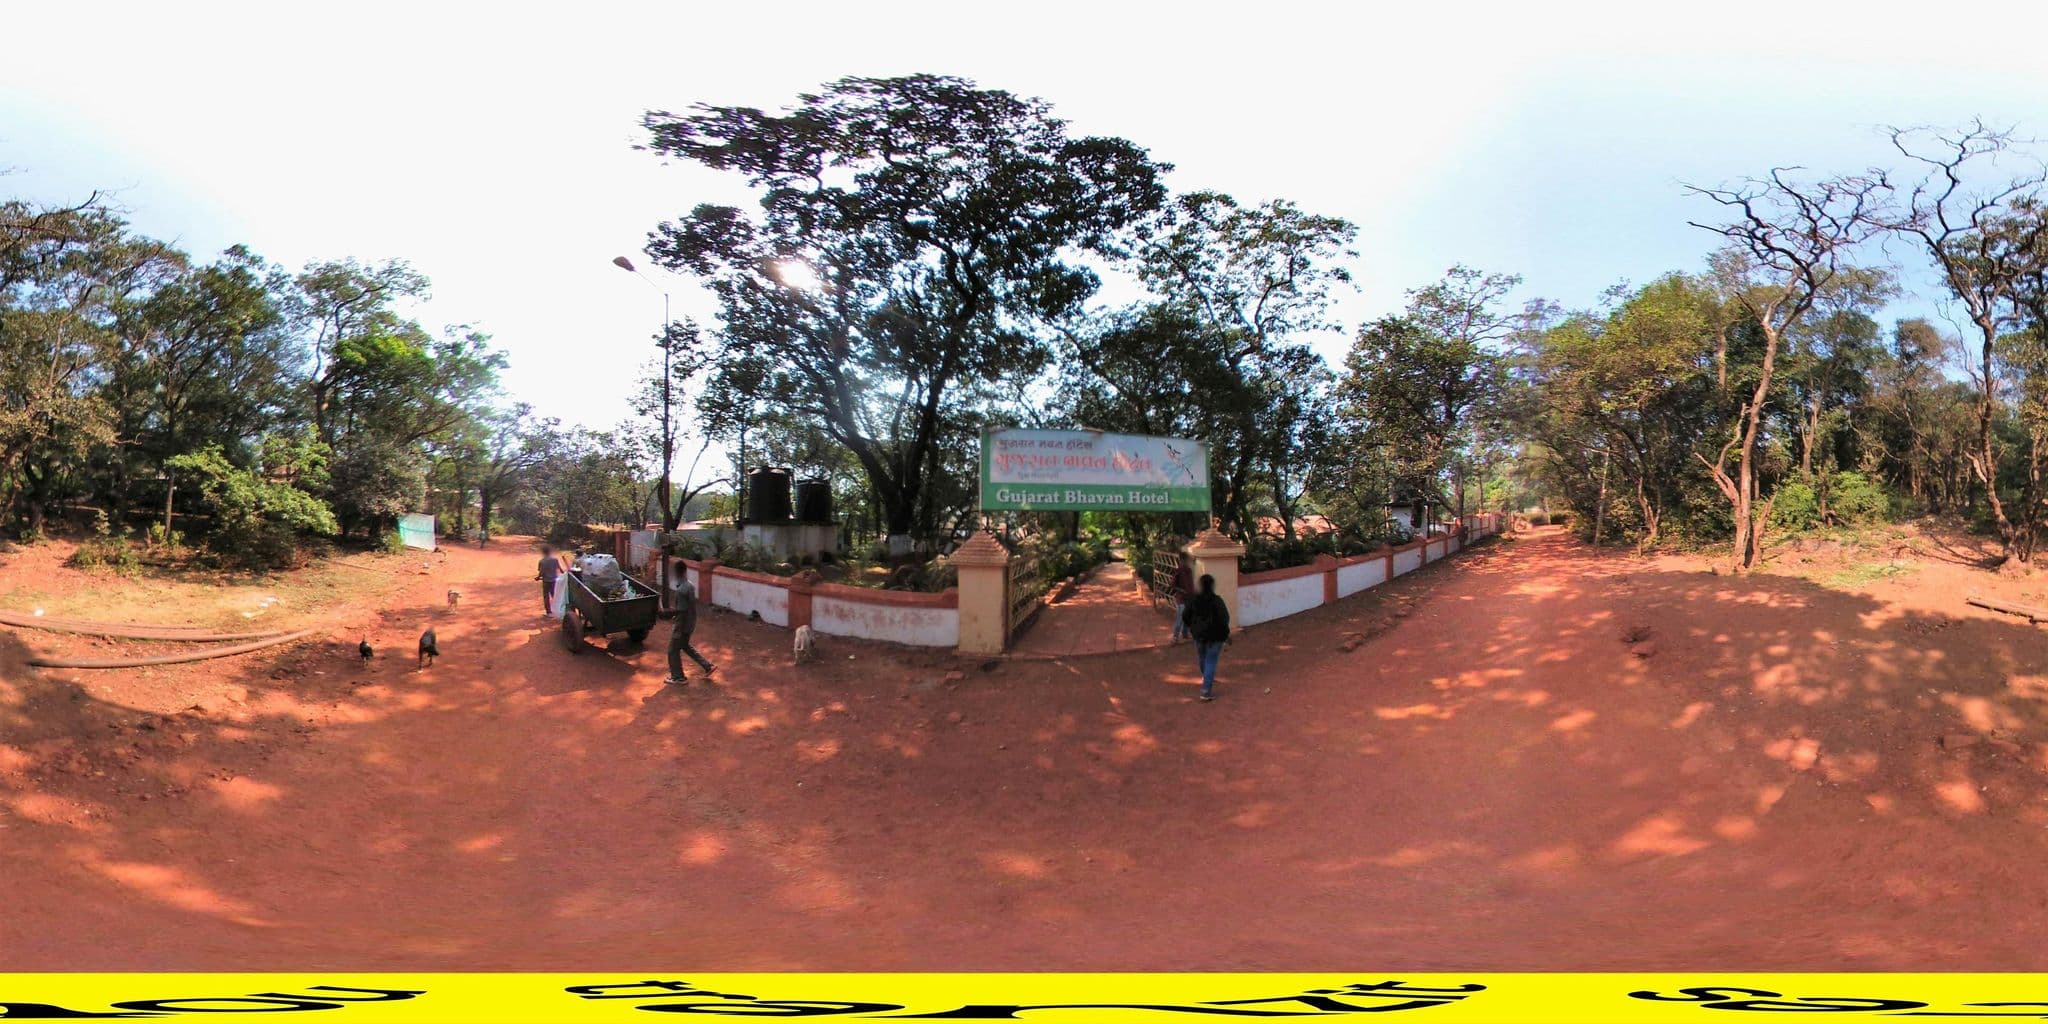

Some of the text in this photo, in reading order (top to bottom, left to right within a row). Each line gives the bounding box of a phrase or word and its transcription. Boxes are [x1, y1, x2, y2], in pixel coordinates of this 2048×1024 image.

[996, 489, 1060, 506] Gujarat
[1064, 490, 1125, 505] Bhavan
[1129, 491, 1169, 505] Hotel
